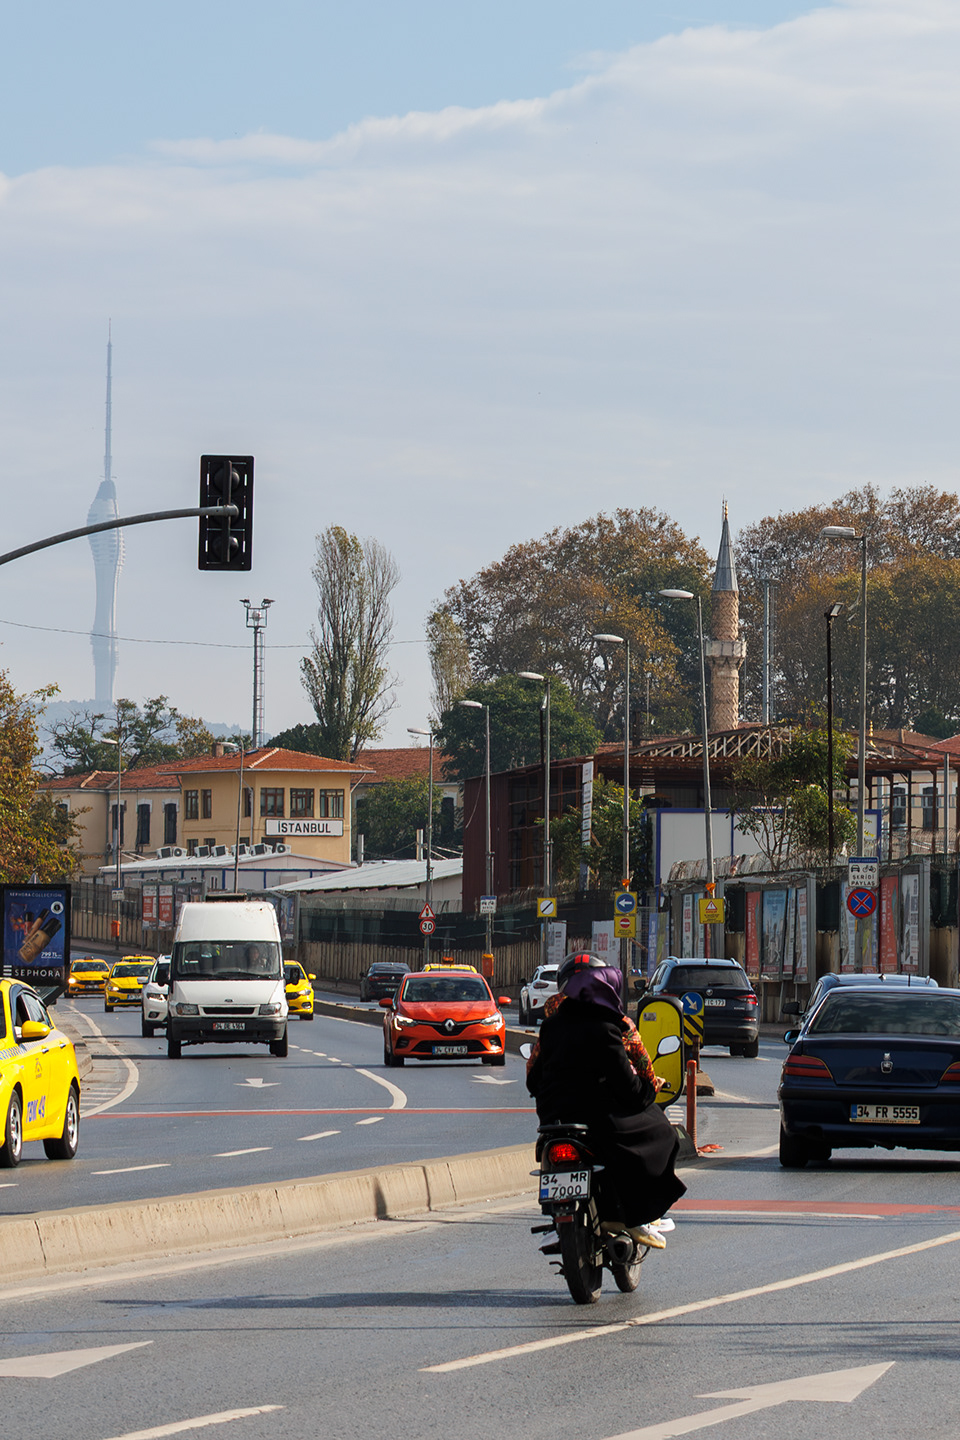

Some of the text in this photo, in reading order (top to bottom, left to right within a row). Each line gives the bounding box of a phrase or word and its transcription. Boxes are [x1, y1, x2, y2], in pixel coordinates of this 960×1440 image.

[277, 820, 331, 833] İSTANBUL
[422, 922, 433, 931] 30
[14, 969, 61, 978] SEPHORA
[857, 1106, 918, 1119] 34 FR 5555
[542, 1172, 587, 1185] 34 MR
[551, 1185, 582, 1197] 7000
